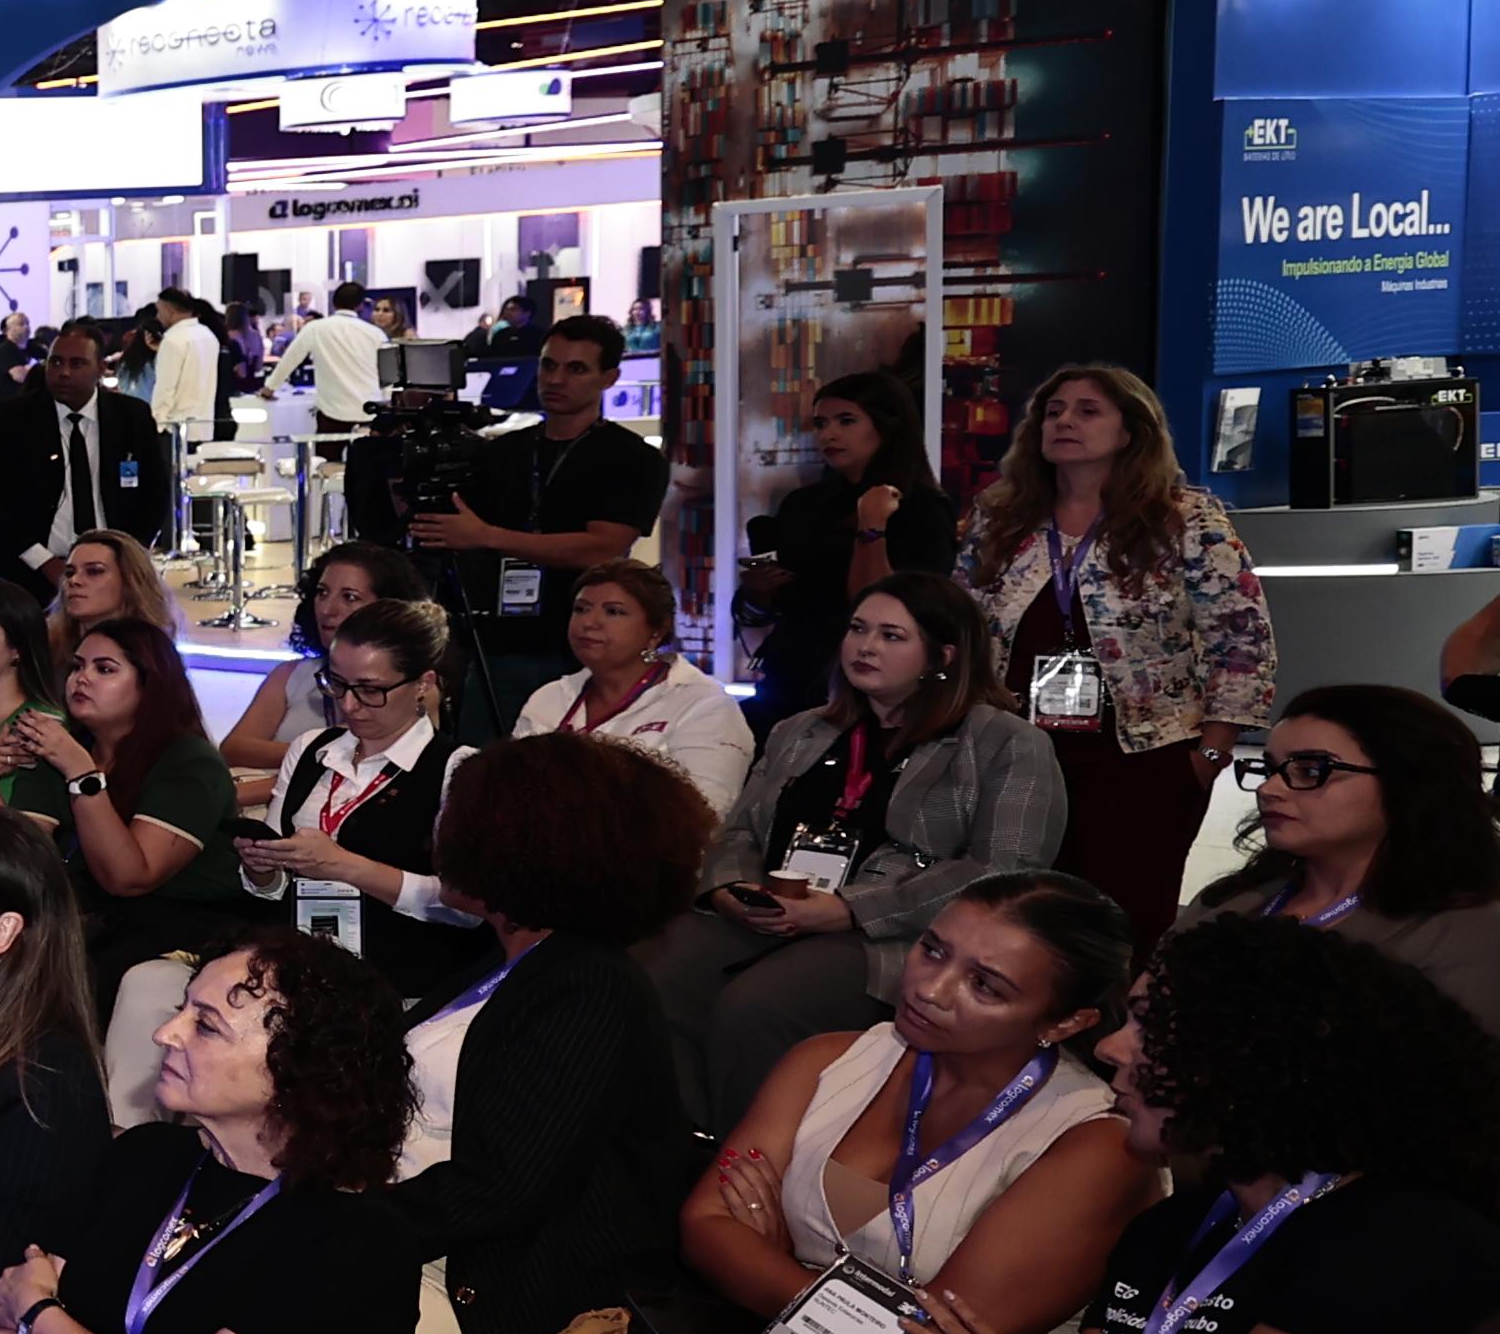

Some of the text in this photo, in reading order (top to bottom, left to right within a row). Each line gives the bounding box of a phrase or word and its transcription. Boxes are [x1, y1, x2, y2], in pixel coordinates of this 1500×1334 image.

[1253, 118, 1290, 145] EKT
[1241, 189, 1450, 244] We are Local...
[1282, 249, 1450, 280] Impulsionando a Energia Global
[1437, 389, 1468, 403] EKT
[985, 1083, 1029, 1124] logcomex
[1241, 1198, 1292, 1244] logcomex
